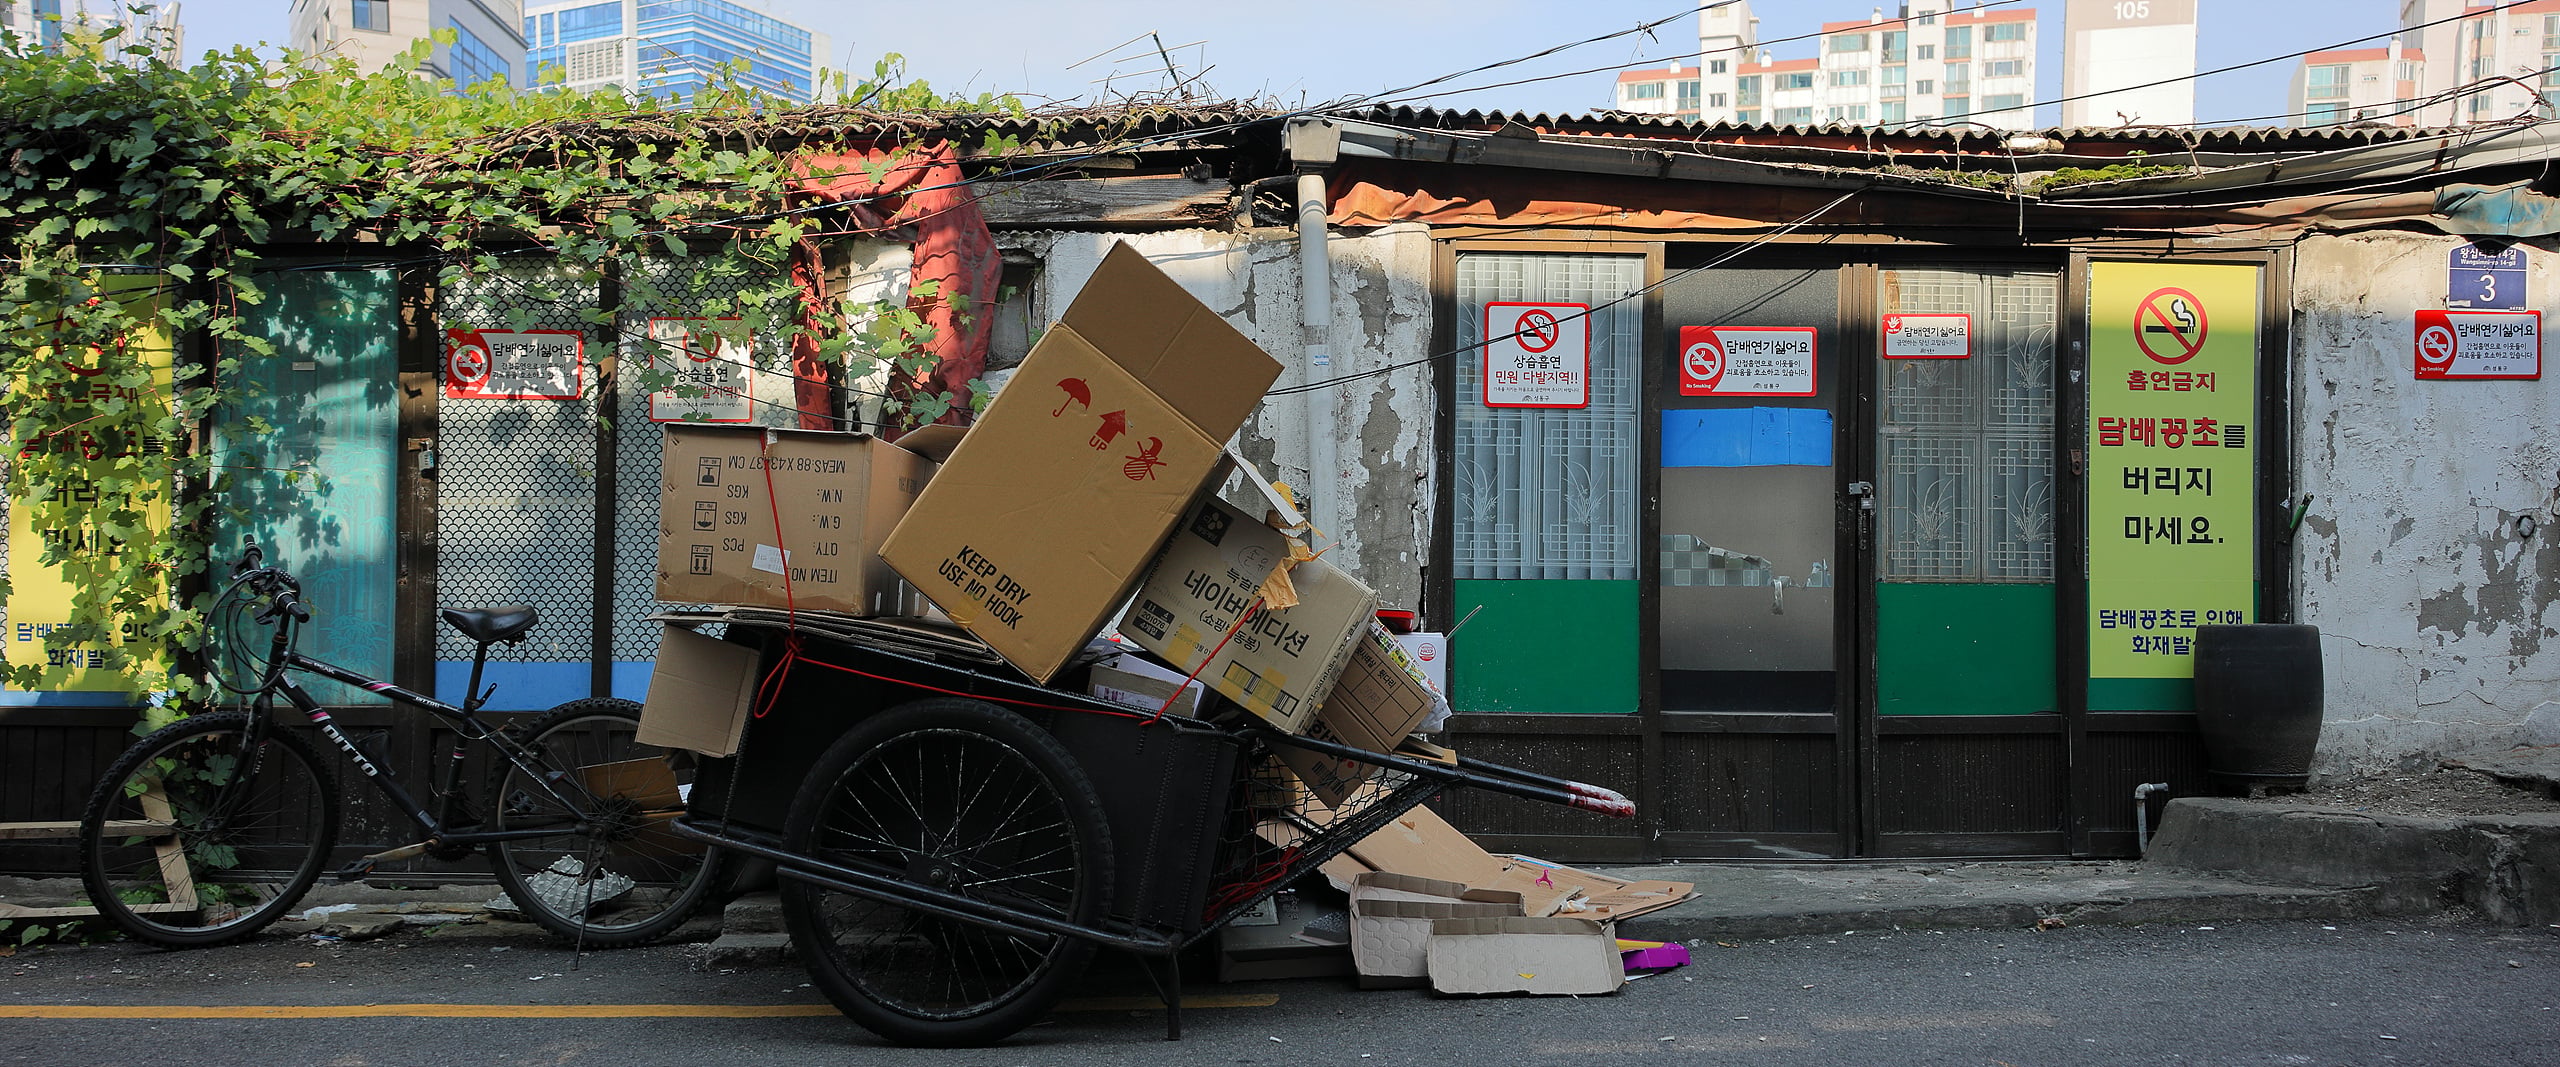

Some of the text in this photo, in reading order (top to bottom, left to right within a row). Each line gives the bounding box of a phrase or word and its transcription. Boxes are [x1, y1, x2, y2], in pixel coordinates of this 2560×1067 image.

[2113, 0, 2150, 20] 105
[2479, 274, 2496, 302] 3
[1904, 327, 1966, 337] 담배연기싫어요
[2458, 324, 2536, 337] 담배연기싫어요
[492, 343, 576, 357] 담배연기싫어요
[1726, 340, 1810, 354] 담배연기싫어요
[1514, 355, 1561, 369] 상습흡연
[676, 366, 728, 383] 상습흡연
[1495, 371, 1578, 384] 민원 다발지역!!
[2127, 370, 2216, 392] 흡연금지
[2098, 417, 2246, 449] 담배꽁초를
[1088, 435, 1108, 451] UP
[727, 455, 746, 470] CM
[2123, 467, 2212, 497] 버리지
[726, 484, 843, 503] N.W.: KGS
[724, 511, 841, 529] G.W.: KGS
[2124, 516, 2224, 545] 마세요.
[722, 538, 746, 551] PCS
[812, 542, 838, 556] QTY:
[810, 568, 838, 584] ITEM
[956, 545, 1031, 605] KEEP DRY
[938, 558, 1024, 630] USE NO HOOK
[2099, 609, 2197, 630] 담배꽁초로
[2132, 635, 2197, 656] 화재발
[48, 648, 106, 669] 화재발
[322, 724, 378, 777] DITTO
